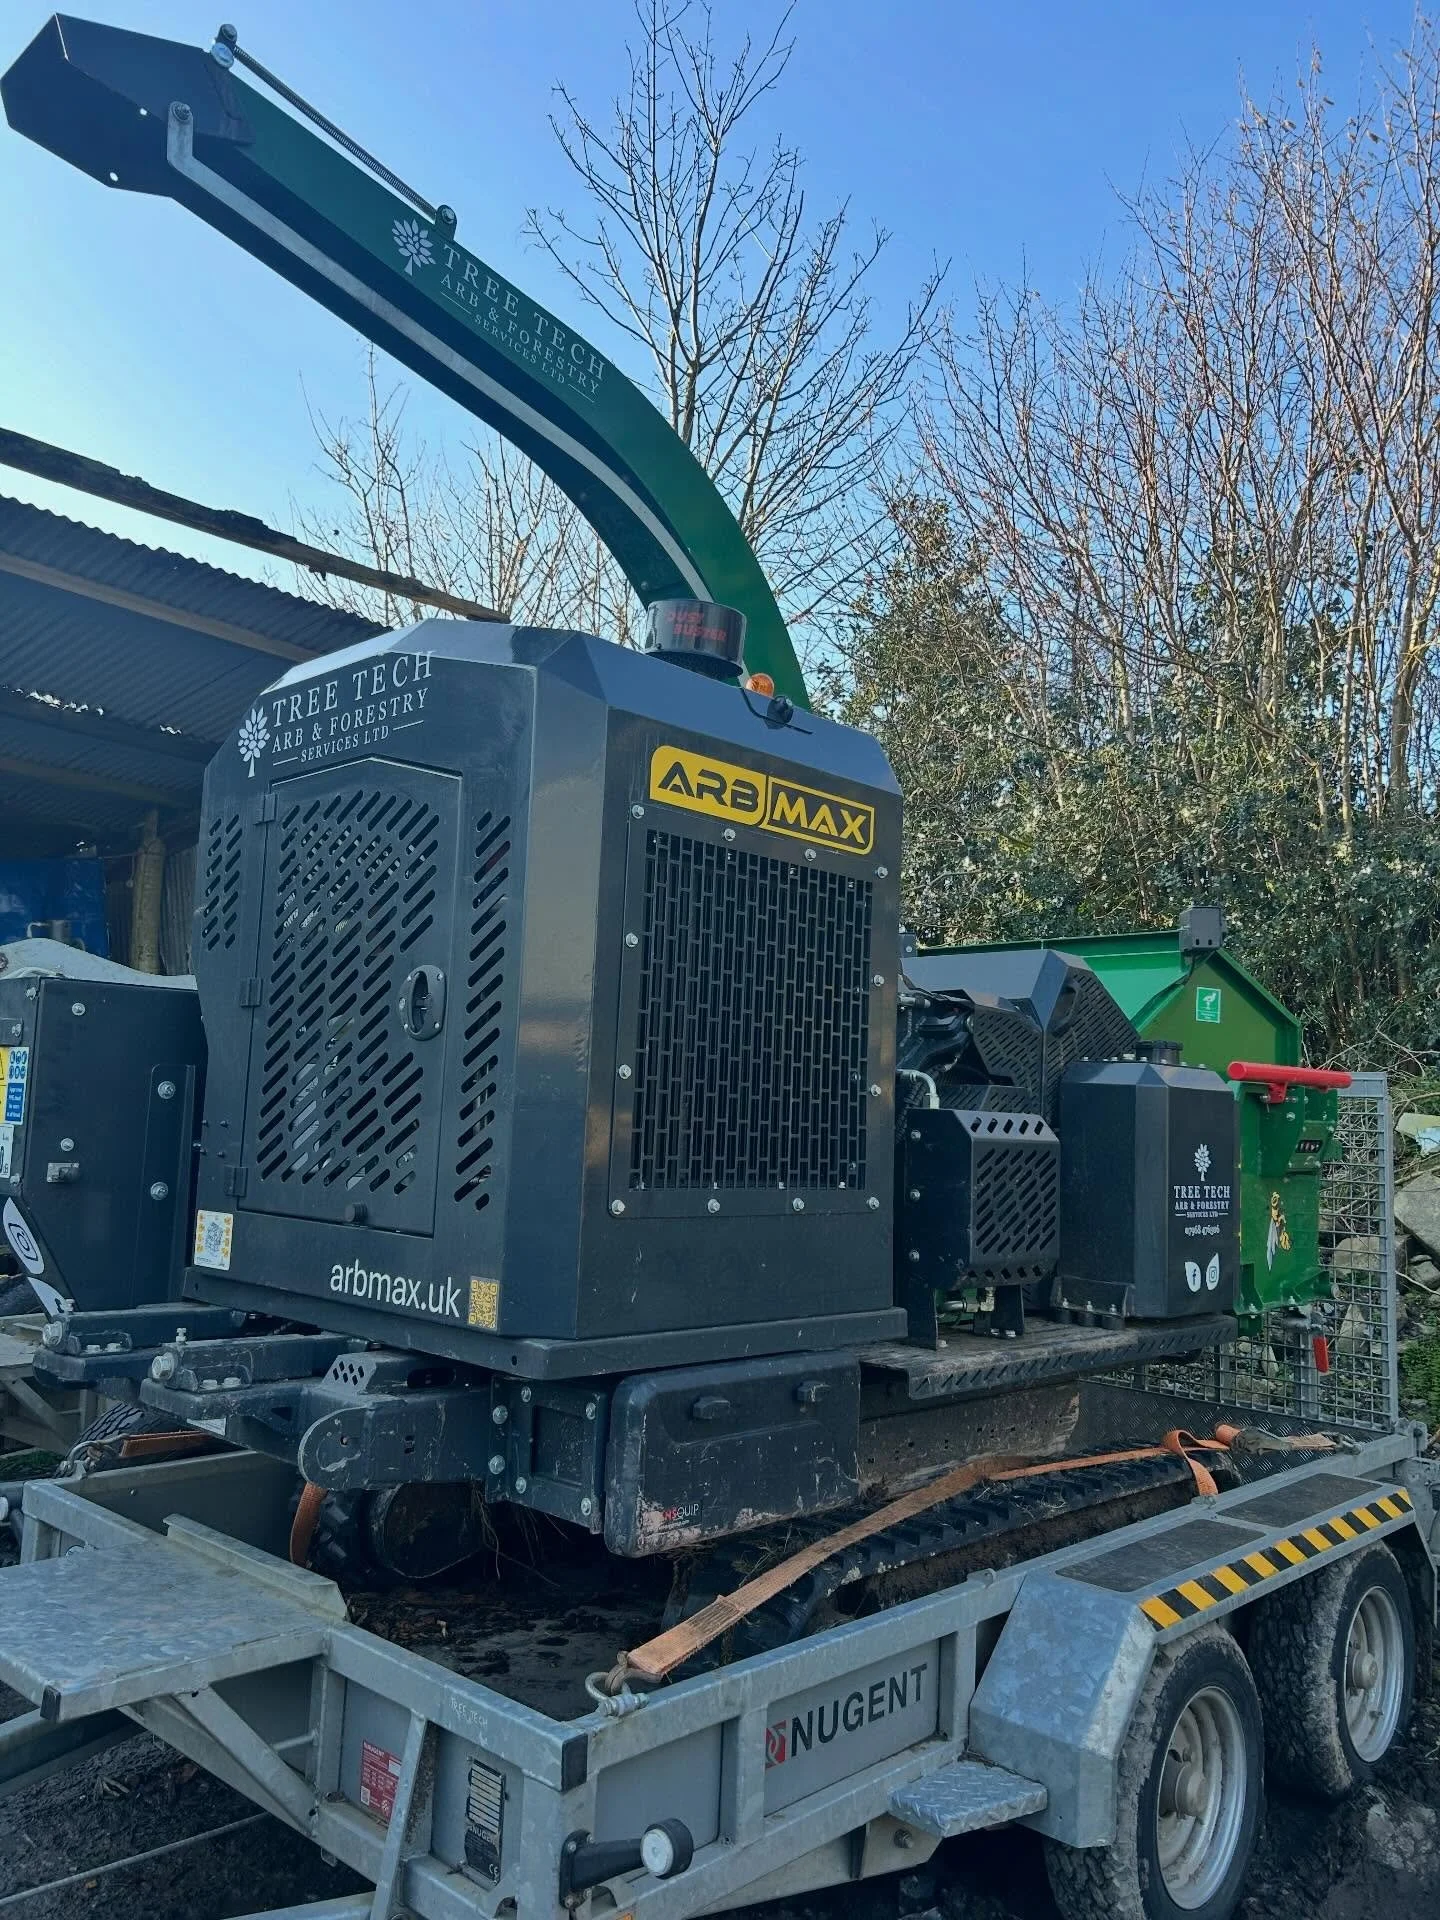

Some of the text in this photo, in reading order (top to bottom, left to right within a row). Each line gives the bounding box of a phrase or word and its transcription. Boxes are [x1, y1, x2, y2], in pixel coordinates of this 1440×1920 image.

[440, 274, 600, 395] ARB & FORESTRY
[443, 243, 606, 380] TREE TECH
[474, 314, 566, 385] SERVICES LTD
[271, 687, 429, 754] ARB & FORESTRY
[272, 652, 433, 728] TREE TECH
[300, 724, 390, 763] SERVICES LTD
[657, 761, 866, 845] ARB MAX
[1173, 1185, 1231, 1199] TREE TECH
[1174, 1201, 1189, 1210] ARB
[1196, 1200, 1230, 1210] FORESTRY
[329, 1257, 462, 1318] arbmax.uk
[791, 1662, 928, 1758] NUGENT
